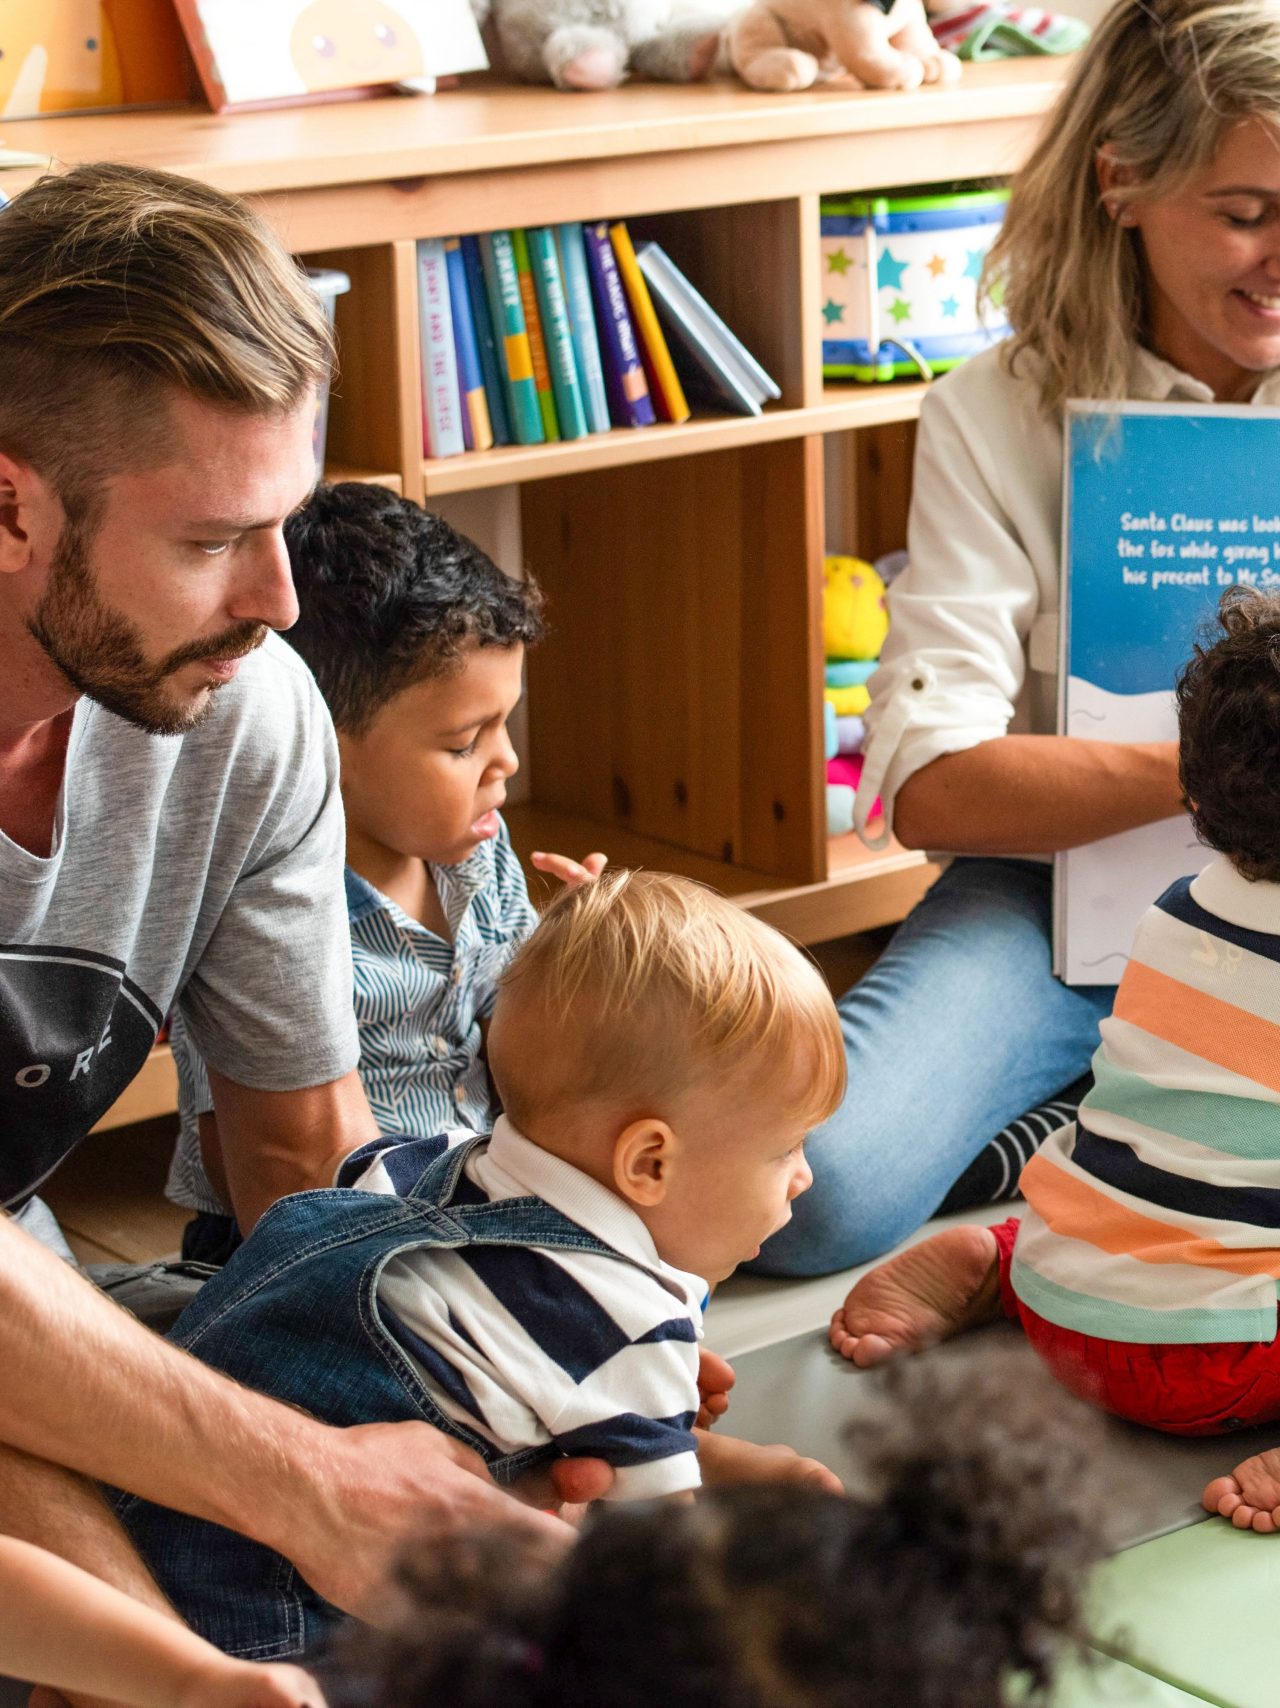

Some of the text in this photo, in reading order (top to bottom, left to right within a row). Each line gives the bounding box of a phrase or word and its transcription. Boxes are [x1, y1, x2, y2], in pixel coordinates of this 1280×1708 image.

[494, 233, 520, 306] SUMMER
[606, 270, 626, 320] MAGIC
[1121, 511, 1166, 533] Santa
[1171, 514, 1213, 533] Claus
[1218, 518, 1248, 534] was
[1118, 539, 1145, 558] the
[1151, 539, 1175, 558] fox
[1180, 541, 1217, 560] while
[1223, 543, 1269, 565] giving
[1123, 567, 1147, 585] his
[1152, 566, 1210, 590] present
[1216, 565, 1232, 586] to
